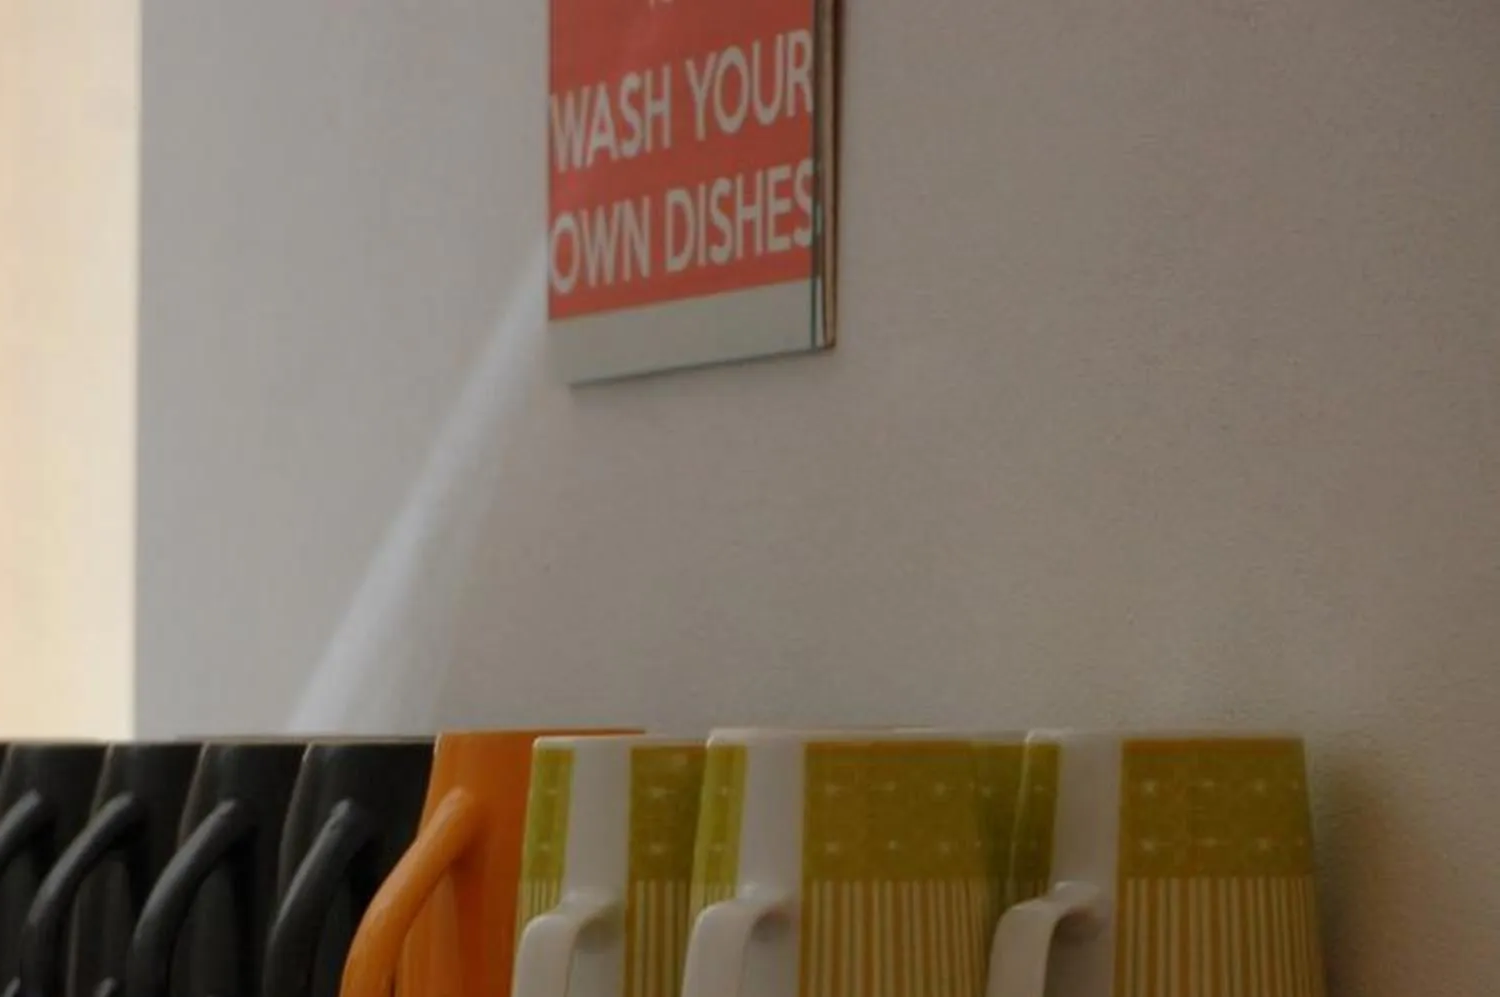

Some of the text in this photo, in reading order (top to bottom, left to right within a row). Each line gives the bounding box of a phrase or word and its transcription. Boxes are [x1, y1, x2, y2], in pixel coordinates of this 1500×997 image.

[550, 29, 812, 173] WASH YOUR
[549, 158, 817, 294] OWN DISHES
